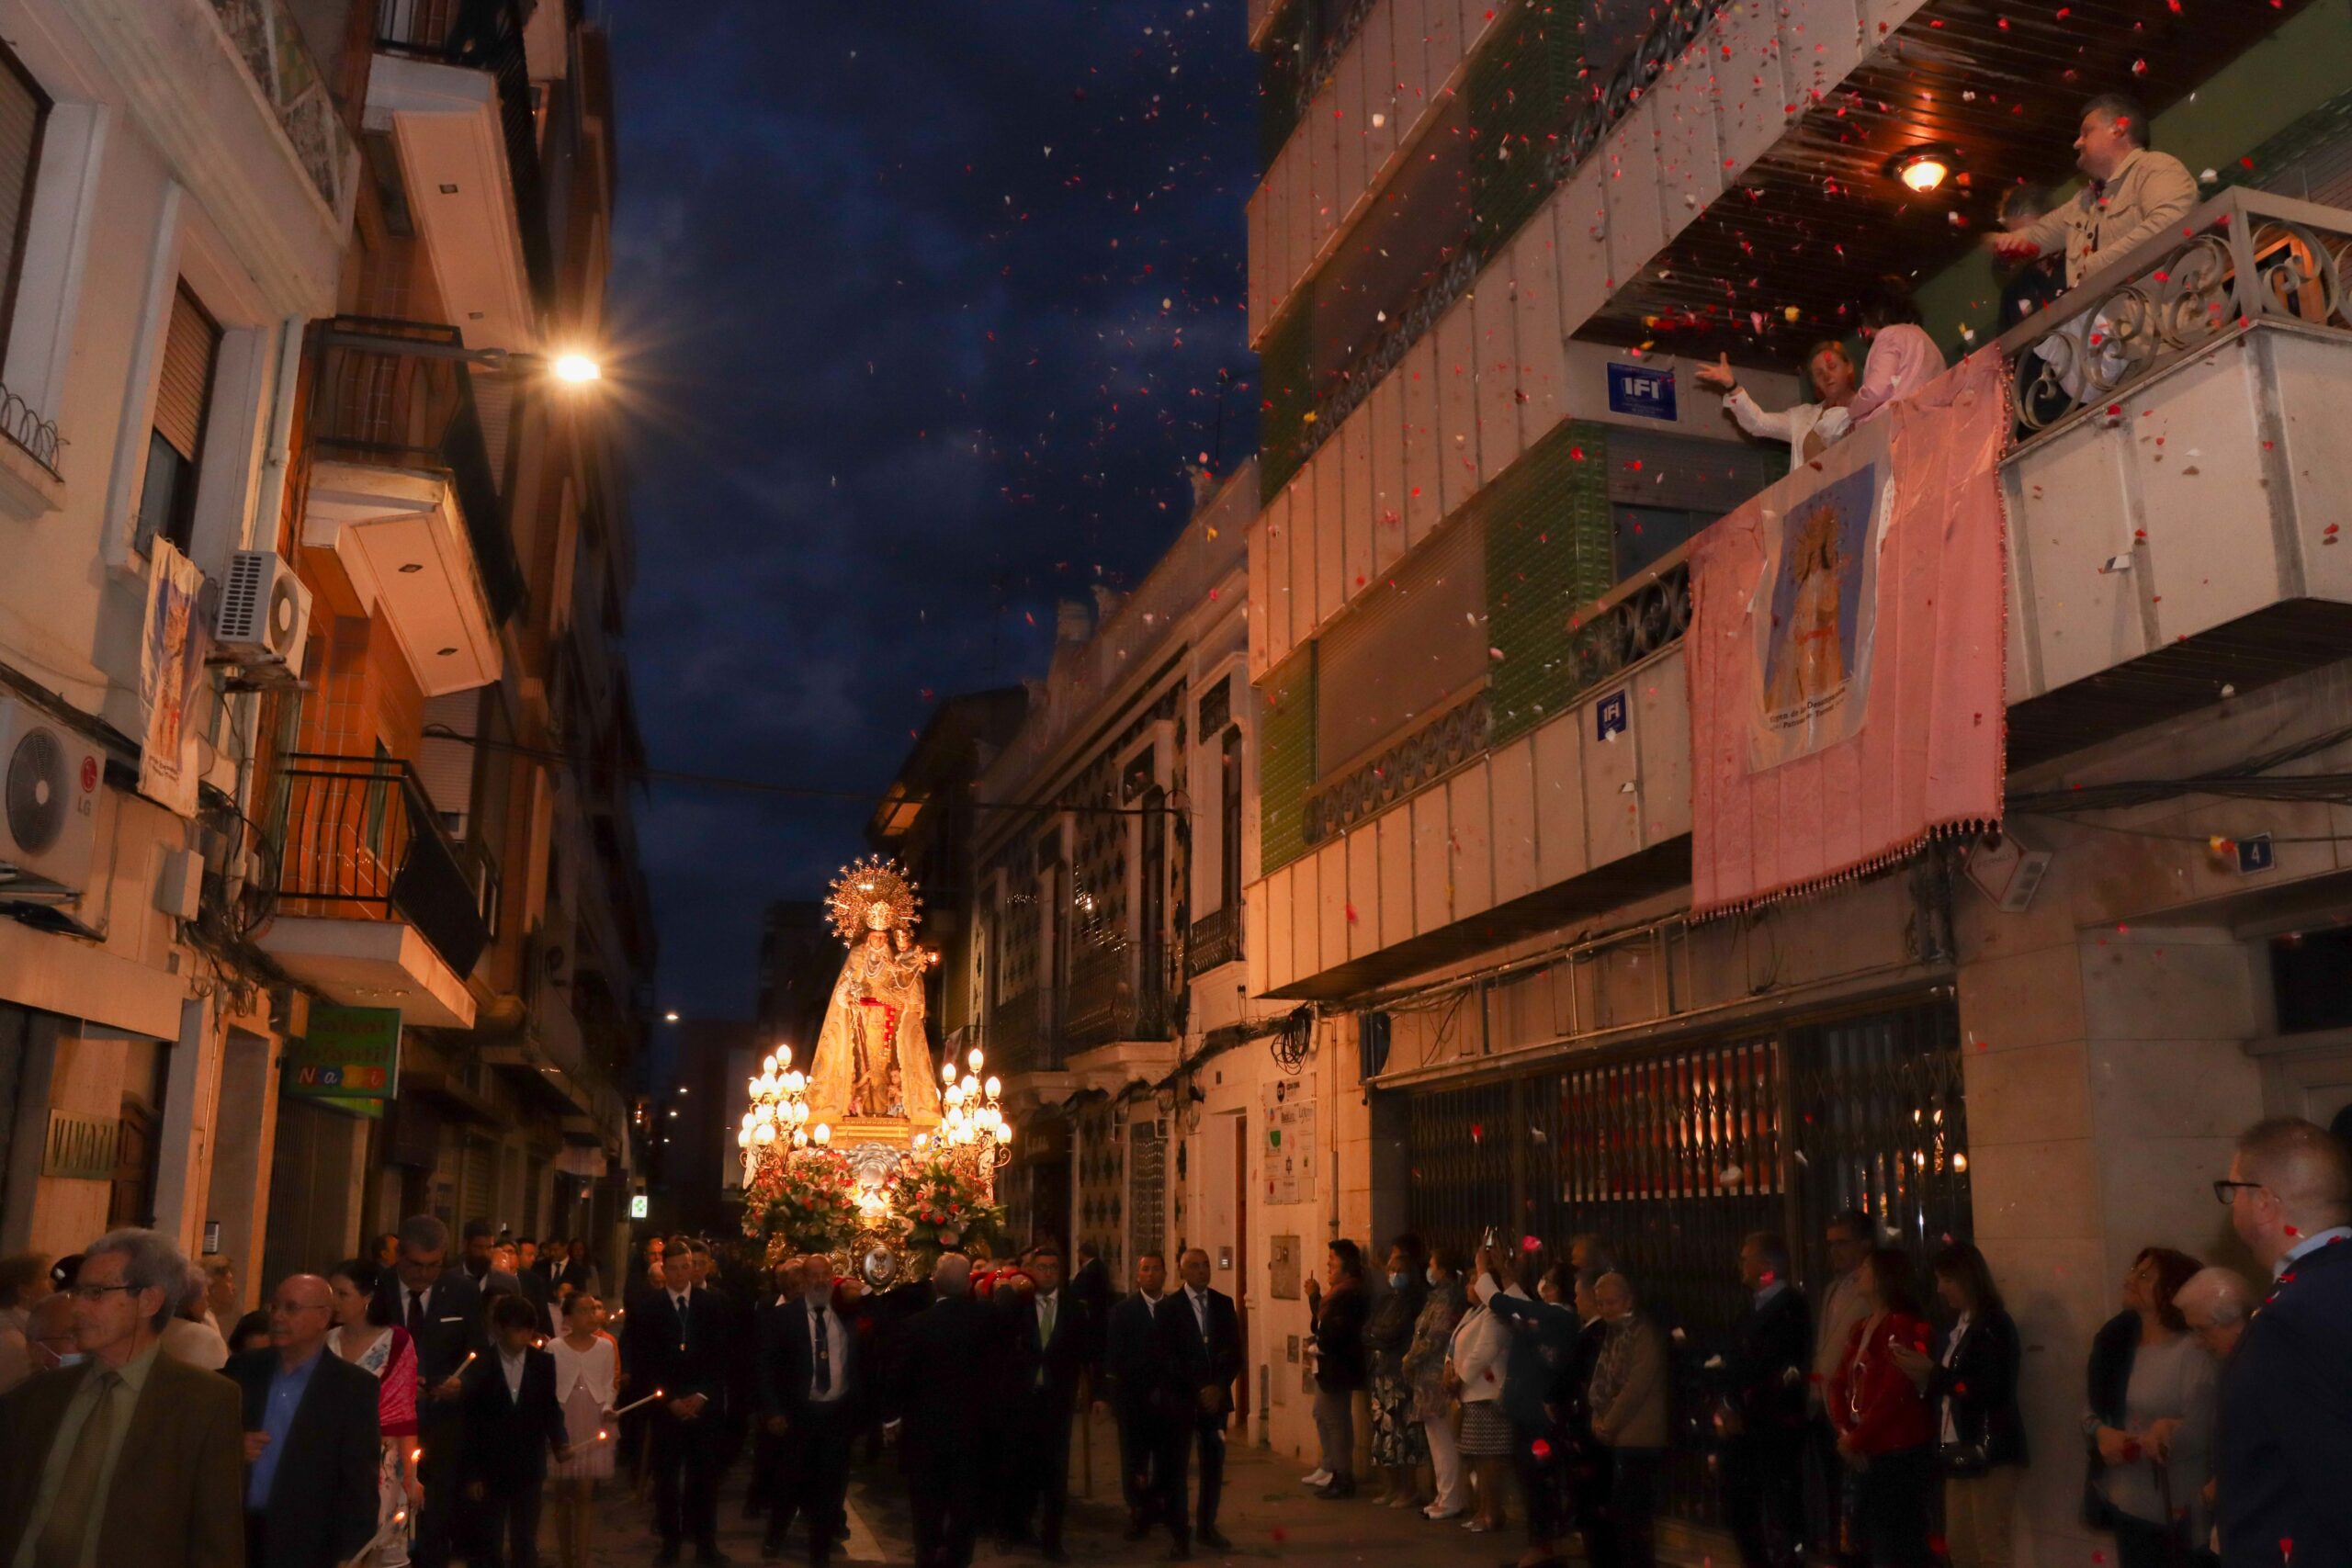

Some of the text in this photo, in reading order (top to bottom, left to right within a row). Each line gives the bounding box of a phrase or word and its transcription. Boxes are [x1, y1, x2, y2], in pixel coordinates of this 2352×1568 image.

[1624, 378, 1659, 399] IFI
[77, 795, 91, 818] LG
[2251, 842, 2260, 863] 4
